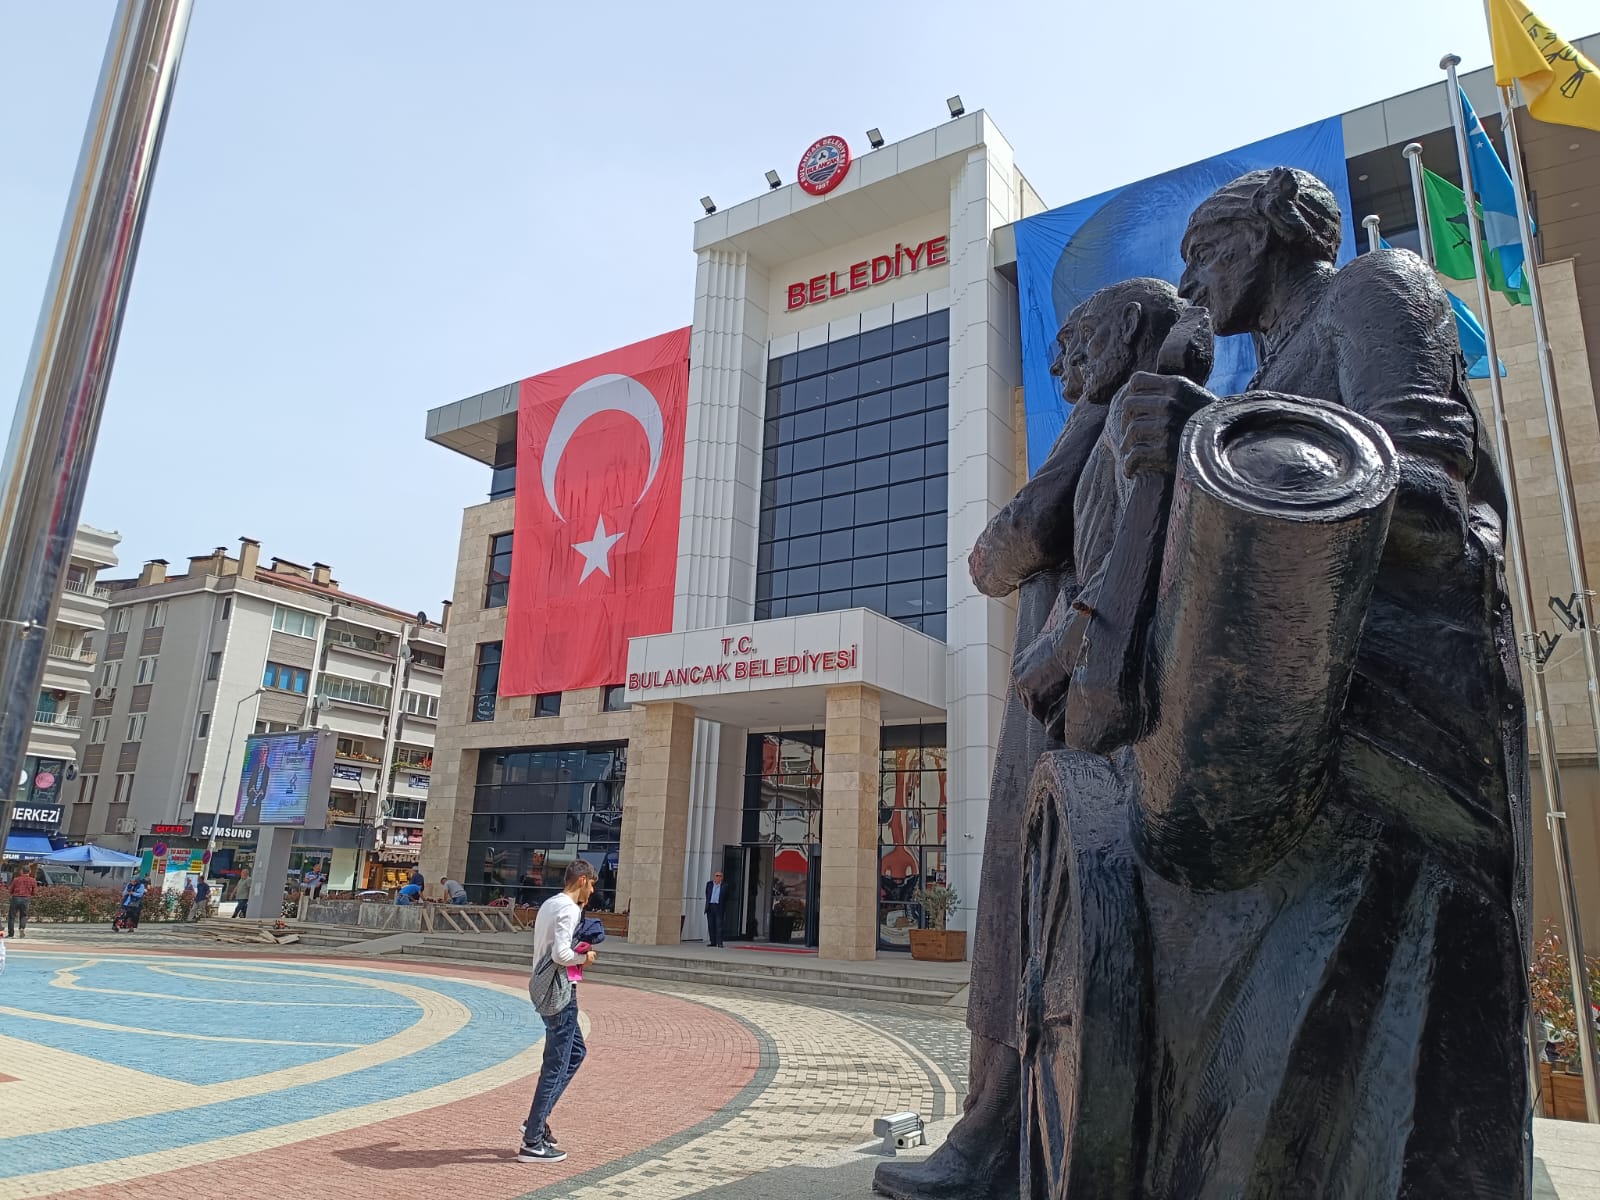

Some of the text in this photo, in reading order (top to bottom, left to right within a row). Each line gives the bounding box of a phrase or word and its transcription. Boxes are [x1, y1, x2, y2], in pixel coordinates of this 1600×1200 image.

[787, 235, 947, 312] BELEDİYE
[721, 636, 757, 656] T.C.
[628, 644, 857, 690] BULANCAK BELEDİYESİ
[12, 807, 60, 823] ERKEZİ
